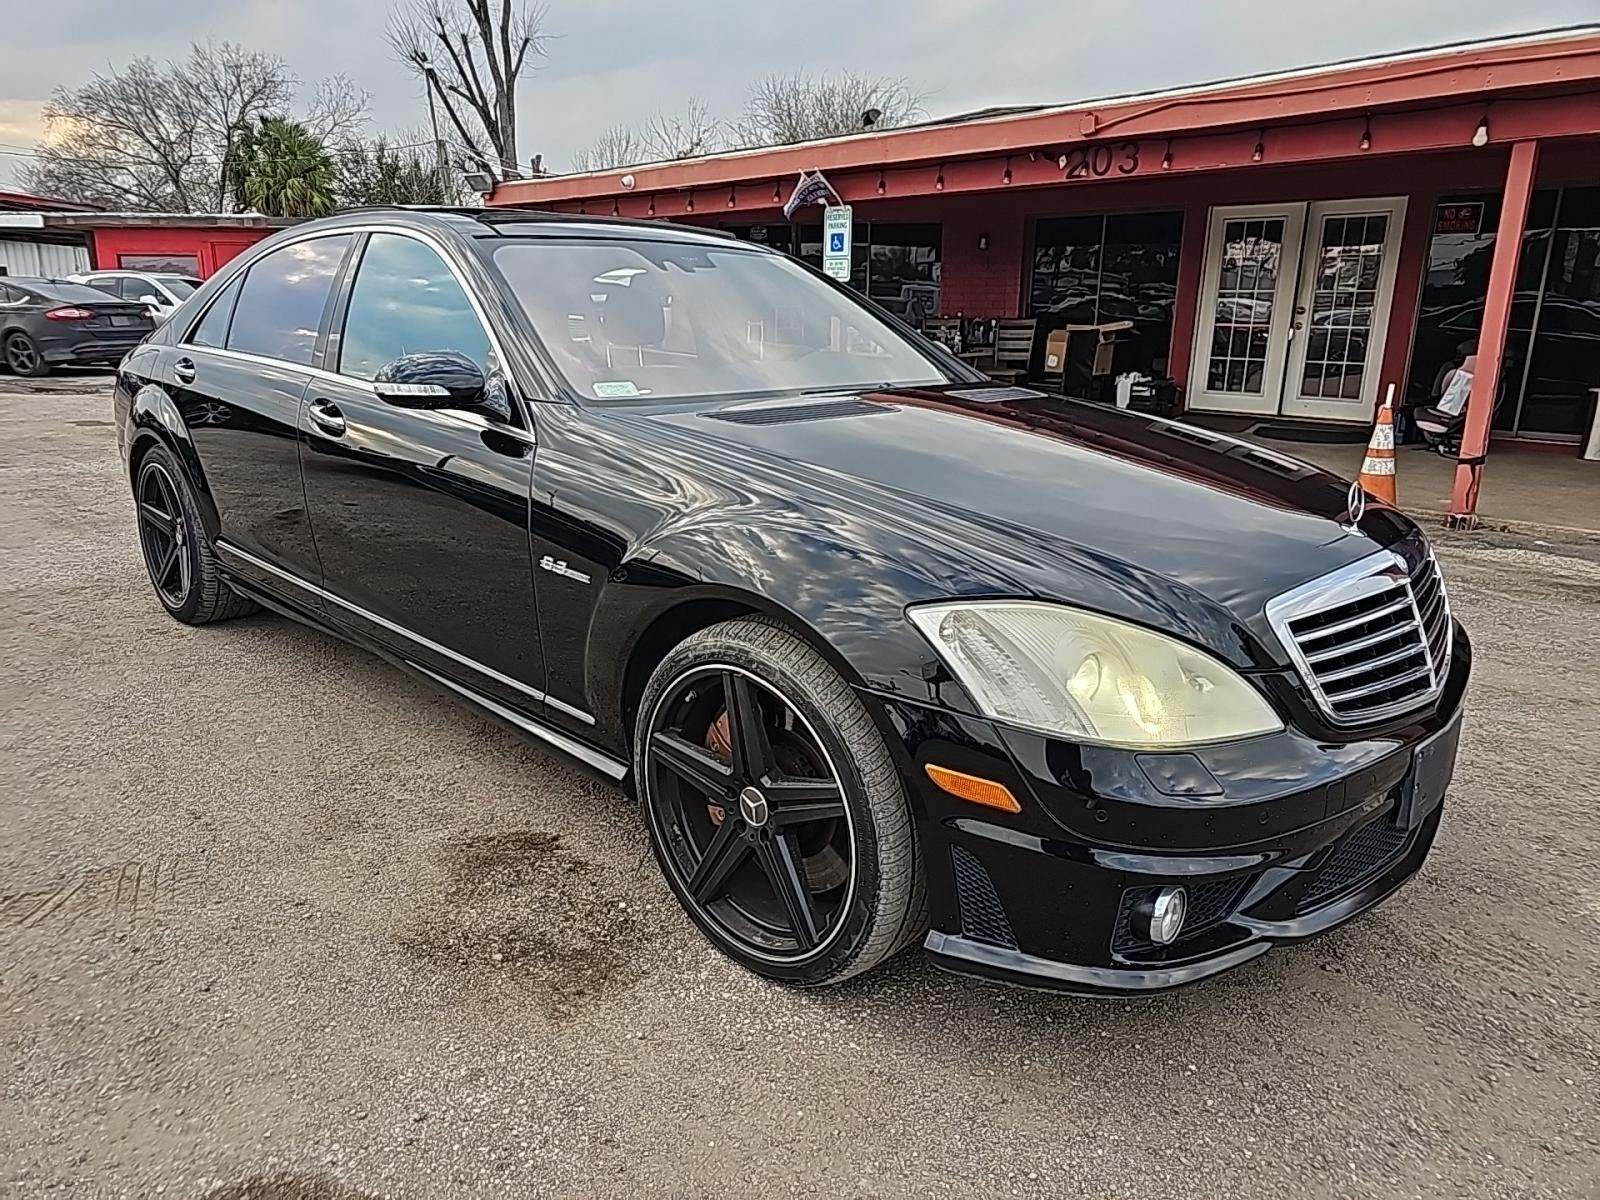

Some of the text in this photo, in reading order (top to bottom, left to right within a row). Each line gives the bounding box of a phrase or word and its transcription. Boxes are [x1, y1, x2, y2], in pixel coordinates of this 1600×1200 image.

[1065, 143, 1140, 179] 203
[1443, 207, 1456, 220] NO
[827, 221, 848, 229] PARKING
